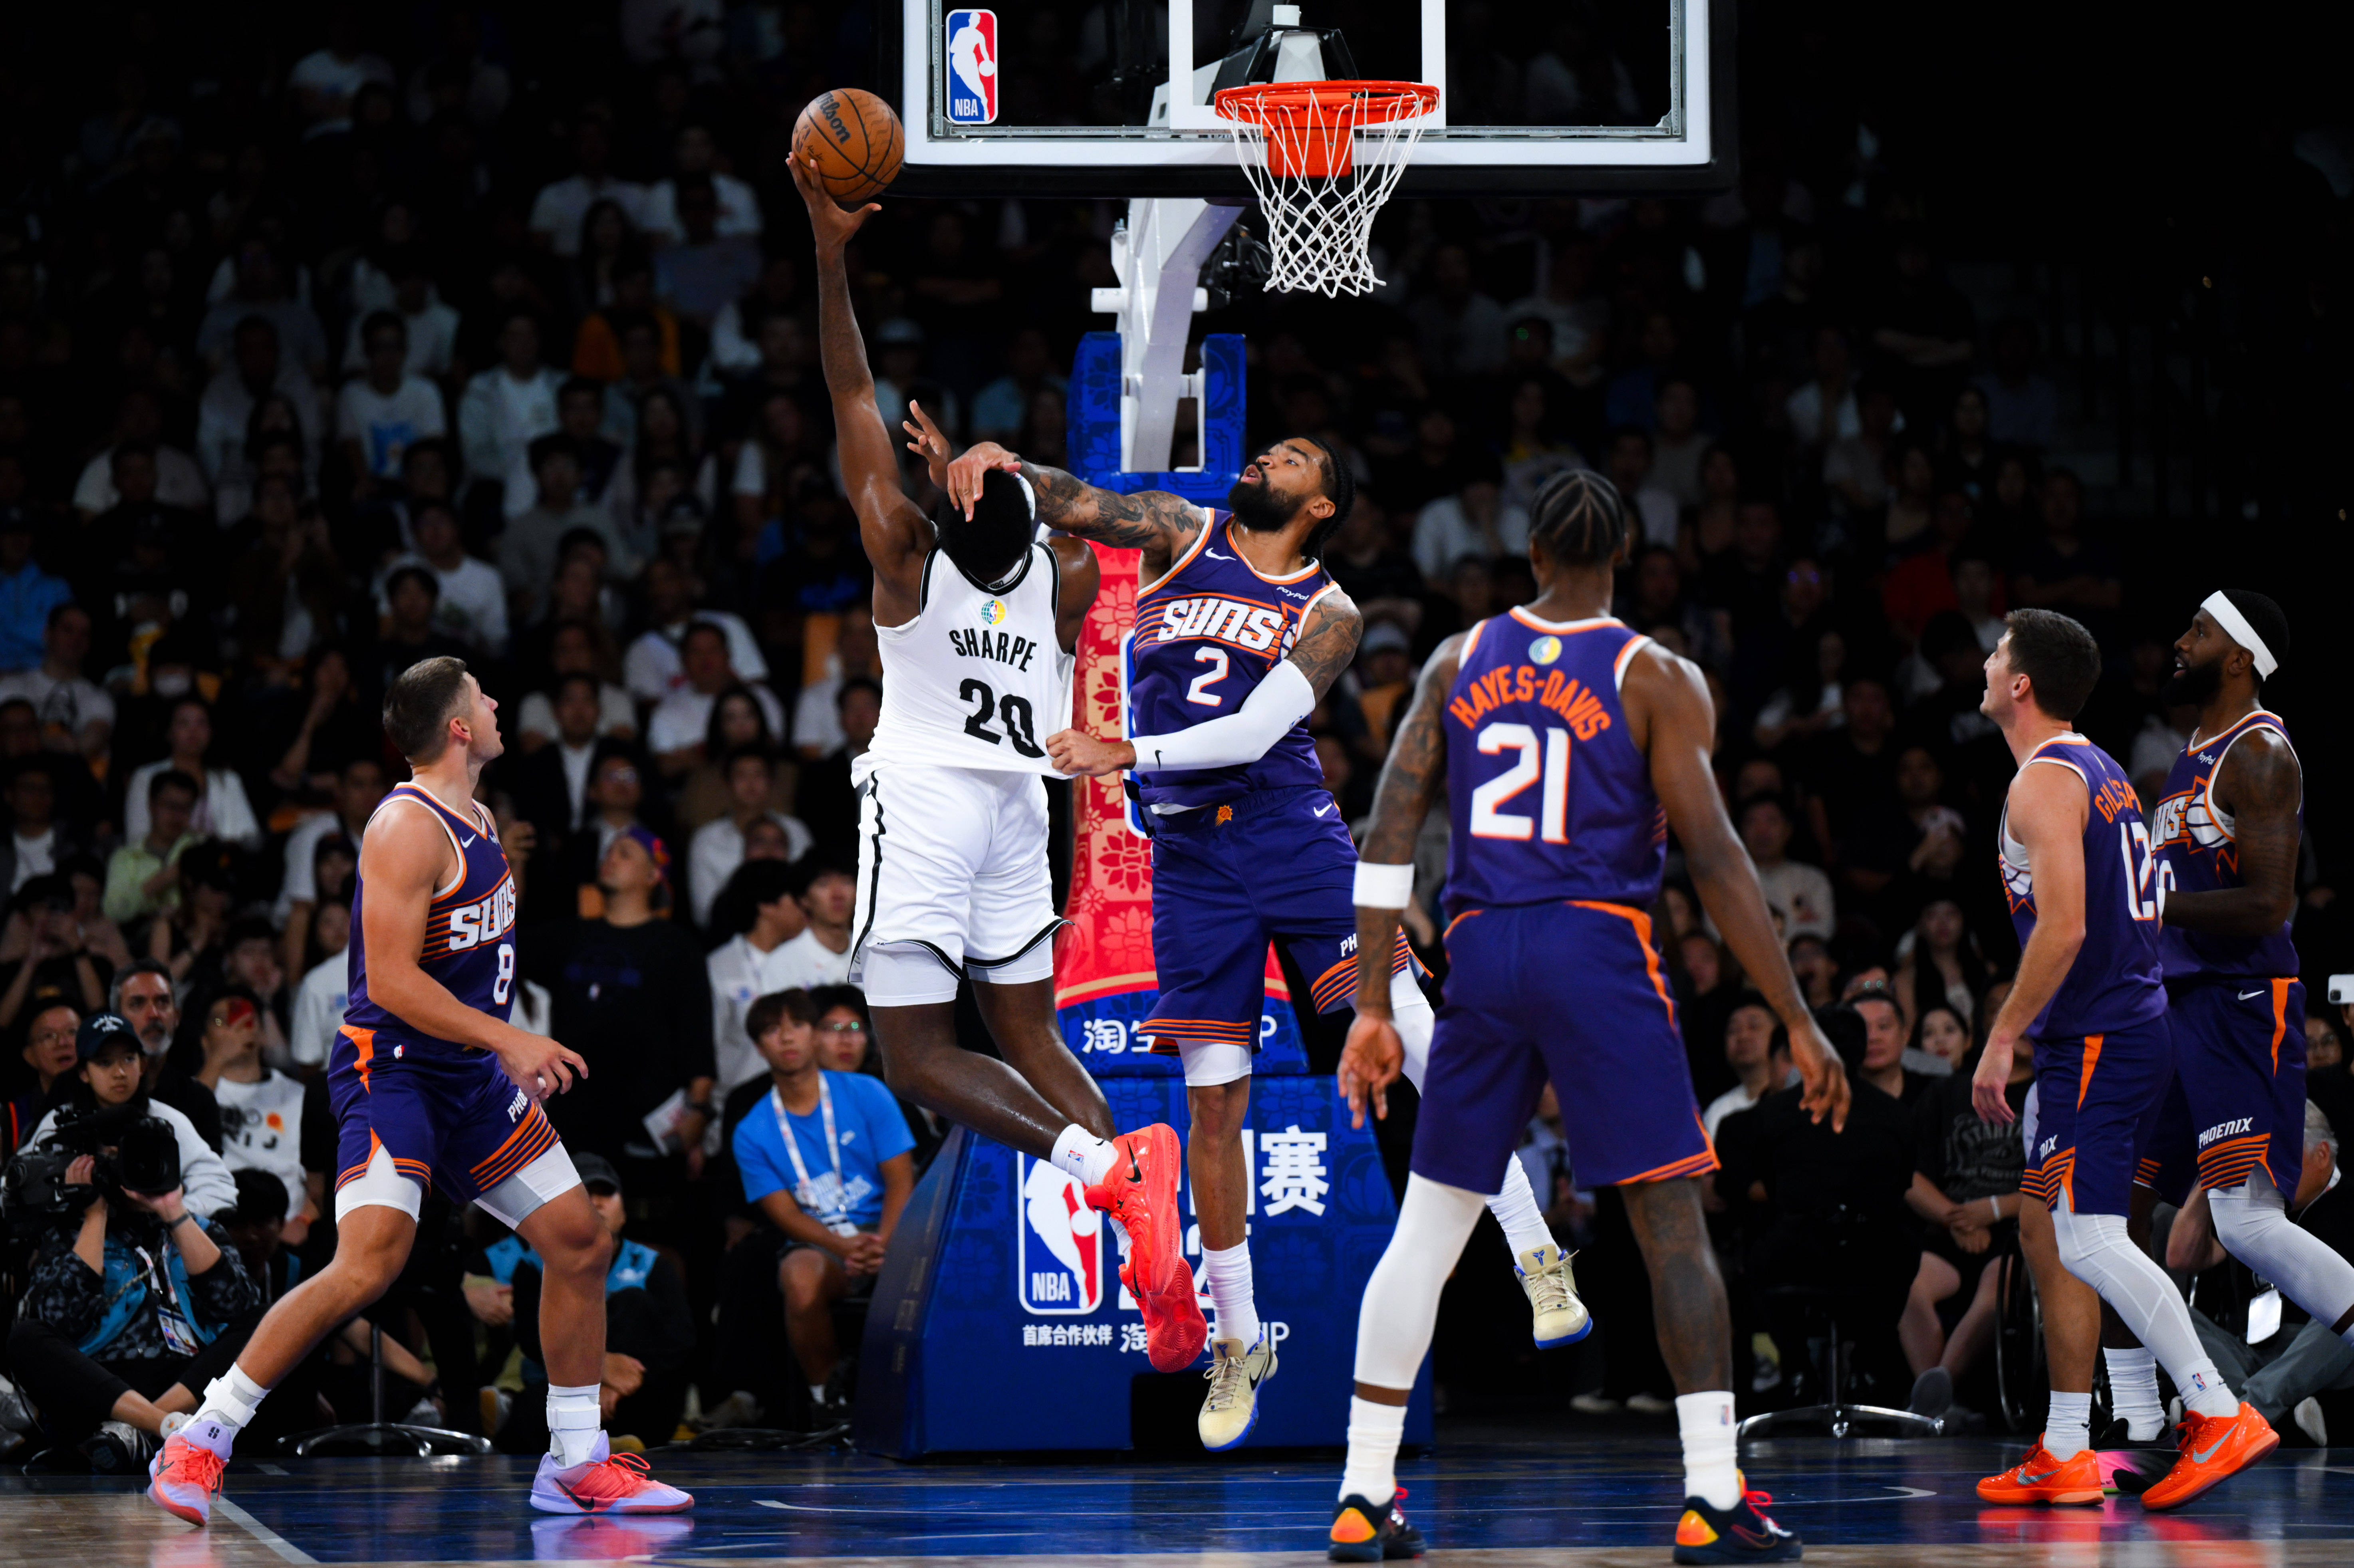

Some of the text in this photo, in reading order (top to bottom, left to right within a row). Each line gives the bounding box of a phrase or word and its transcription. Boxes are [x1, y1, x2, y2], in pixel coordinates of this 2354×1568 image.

[955, 98, 979, 117] NBA
[1276, 586, 1310, 601] PayPal
[949, 628, 1037, 673] SHARPE
[1158, 598, 1285, 651] SUNS
[1186, 647, 1229, 707] 2
[1449, 665, 1612, 741] HAYES-DAVIS
[959, 678, 1046, 758] 20
[1470, 722, 1572, 845] 21
[2197, 751, 2216, 765] PayPal
[2150, 796, 2186, 851] UNS
[2120, 822, 2156, 921] 12
[449, 872, 516, 951] SUNS
[493, 943, 514, 1005] 8
[2199, 1117, 2253, 1149] PHOENIX
[1032, 1272, 1072, 1302] NBA
[1022, 1324, 1113, 1346] 首席合作伙伴
